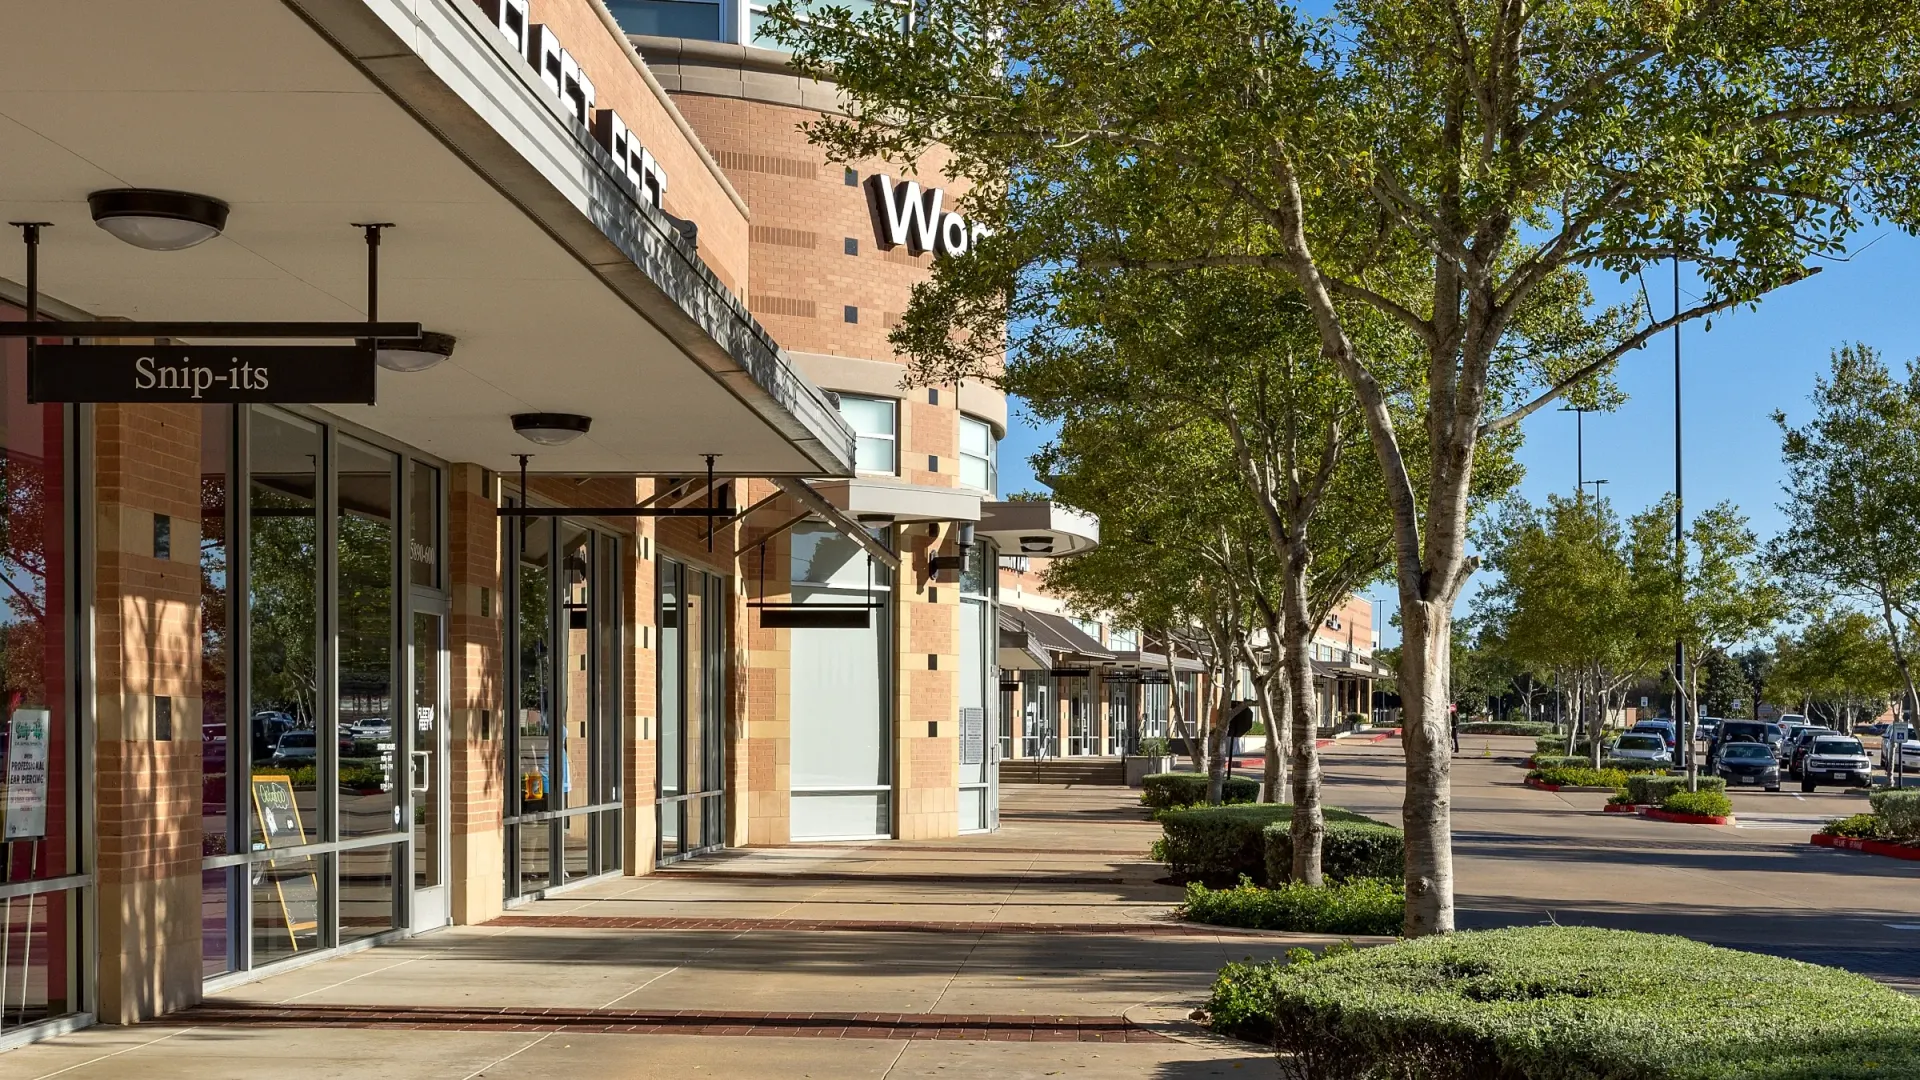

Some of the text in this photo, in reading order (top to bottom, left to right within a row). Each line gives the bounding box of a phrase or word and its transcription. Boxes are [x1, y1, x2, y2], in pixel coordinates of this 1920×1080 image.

[135, 356, 269, 399] Snip-its
[417, 707, 430, 719] FLEET
[418, 719, 429, 731] FEET
[11, 761, 45, 771] PROFESSIONAL
[10, 774, 44, 784] EAR PIERCING
